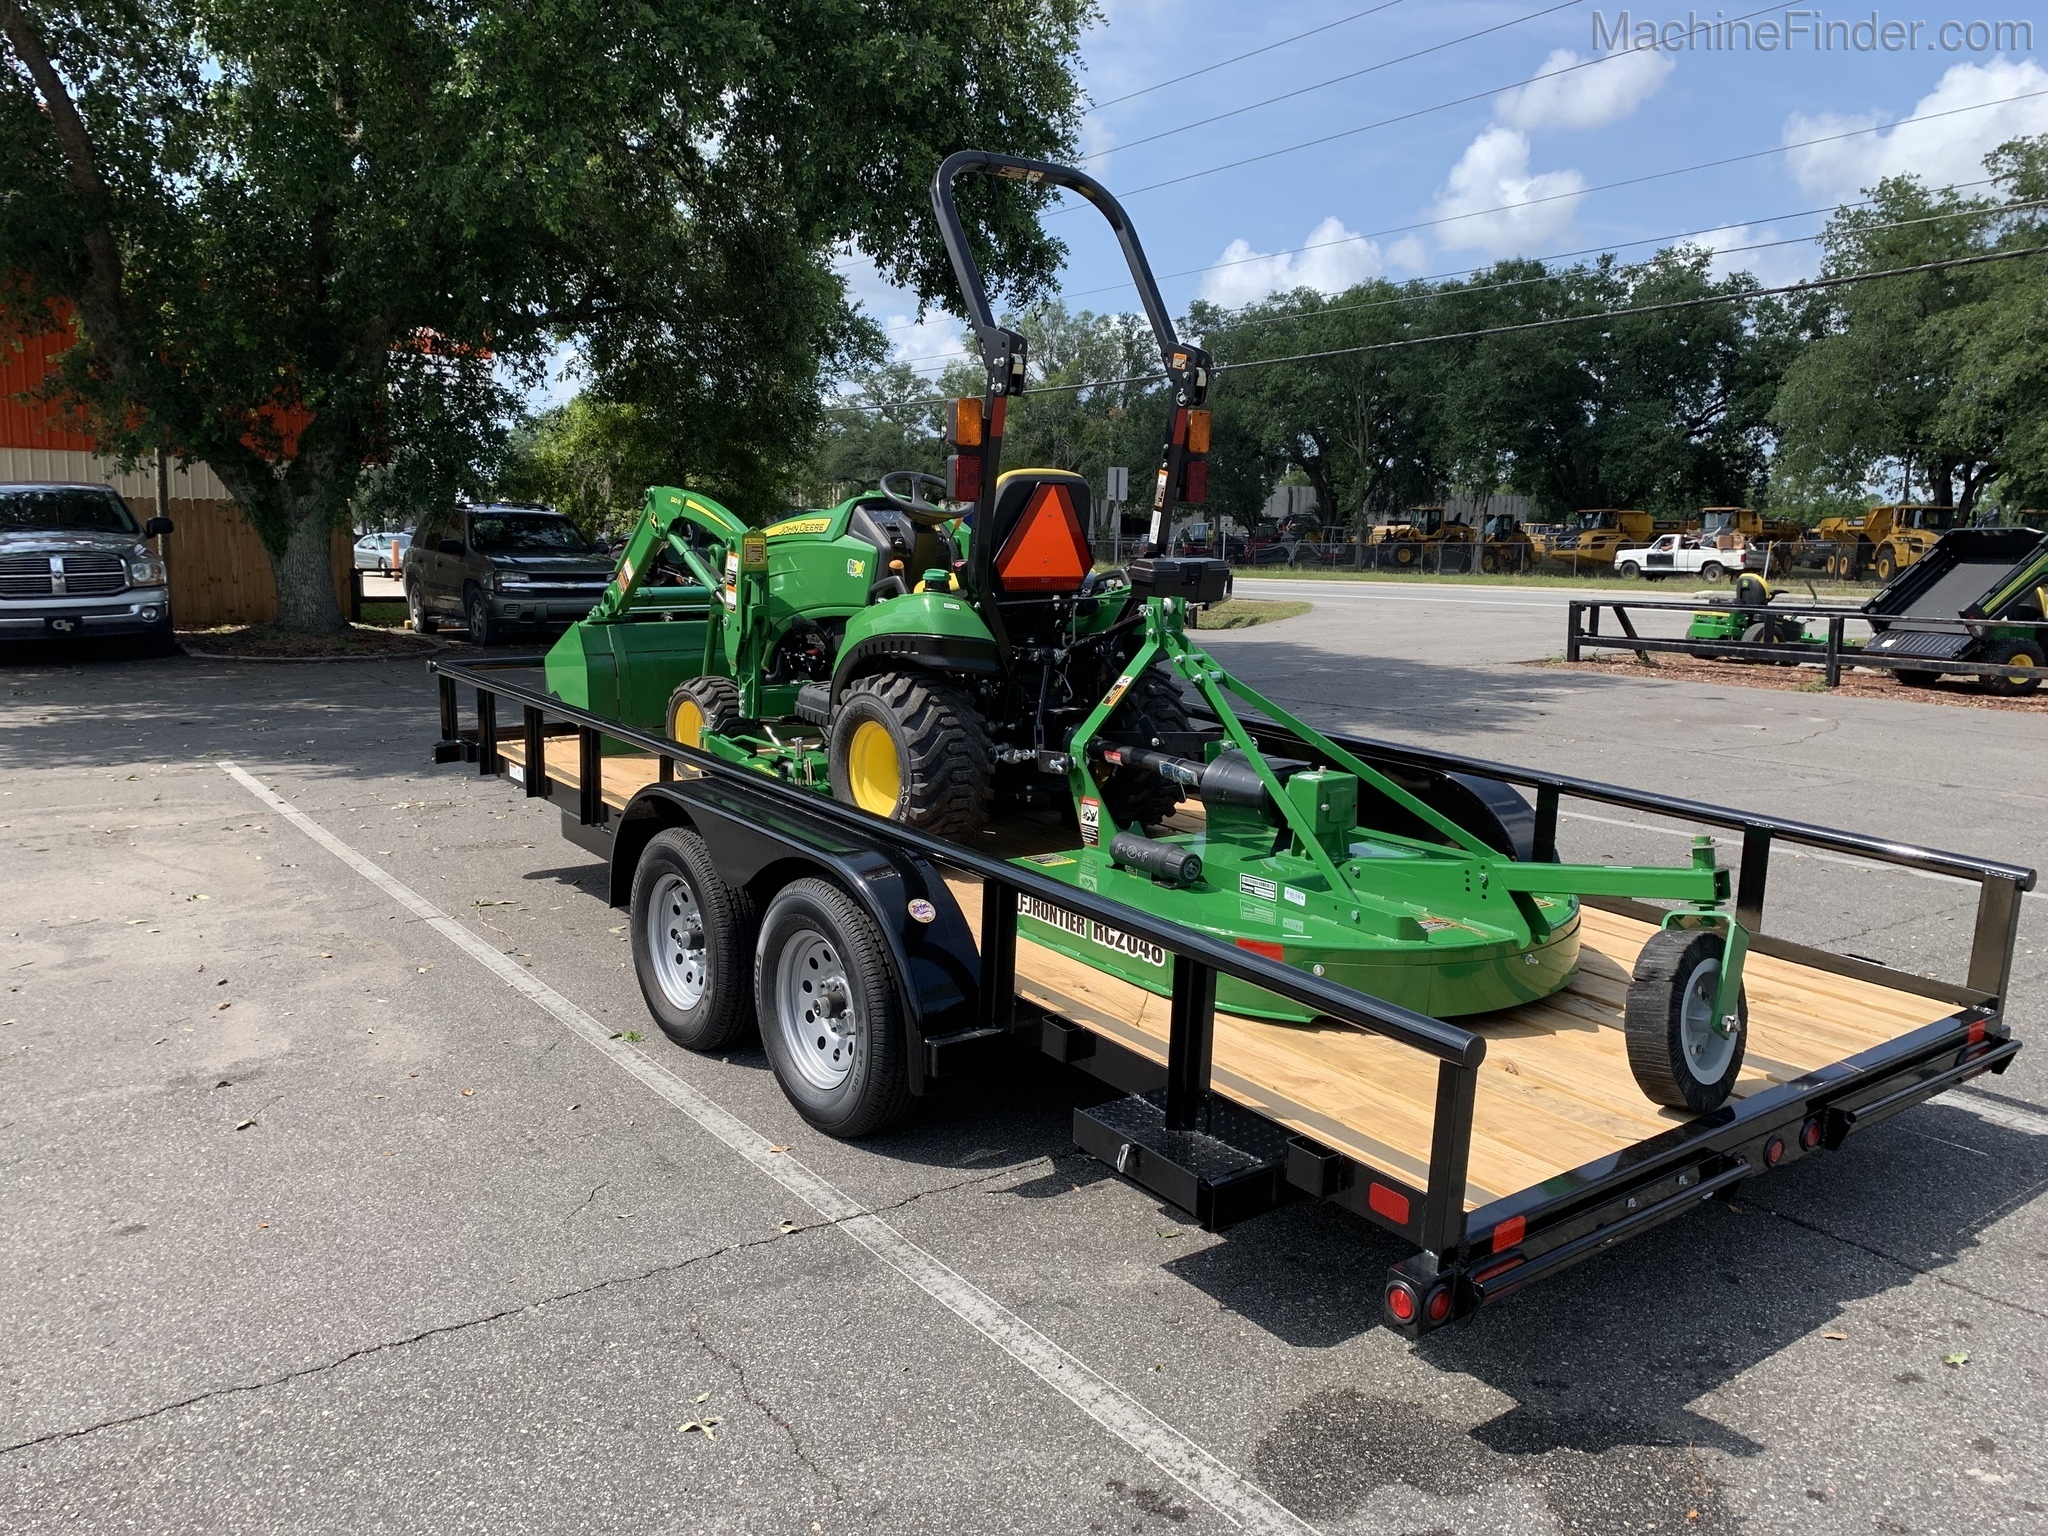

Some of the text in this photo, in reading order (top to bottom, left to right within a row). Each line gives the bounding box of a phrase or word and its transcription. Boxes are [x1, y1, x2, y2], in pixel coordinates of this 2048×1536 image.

[779, 523, 825, 534] JOHN DEERE
[1017, 892, 1086, 937] FRONTIER
